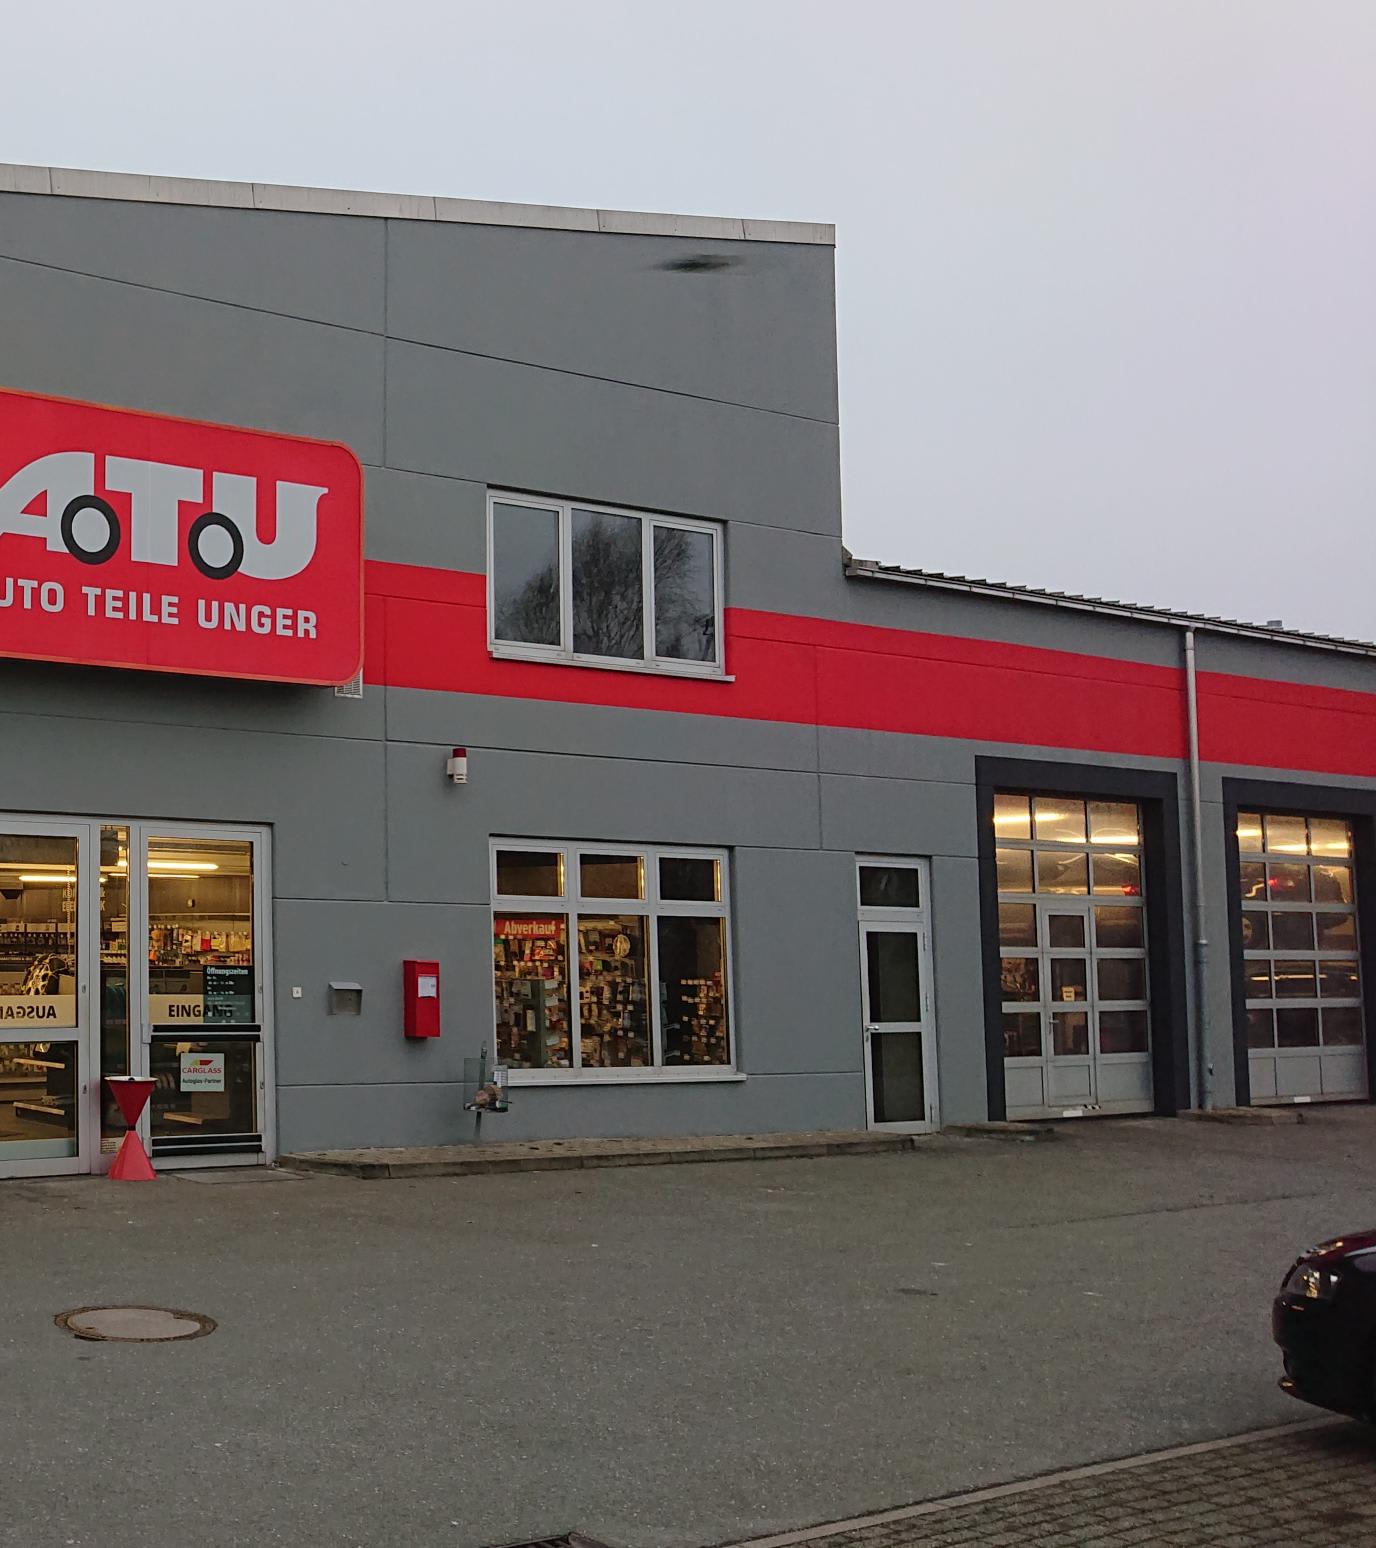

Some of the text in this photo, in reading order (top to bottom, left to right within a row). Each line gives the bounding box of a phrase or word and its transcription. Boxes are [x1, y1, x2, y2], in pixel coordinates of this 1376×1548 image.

[81, 586, 180, 625] TEILE
[197, 598, 318, 639] UNGER
[504, 920, 557, 935] Abverkauf
